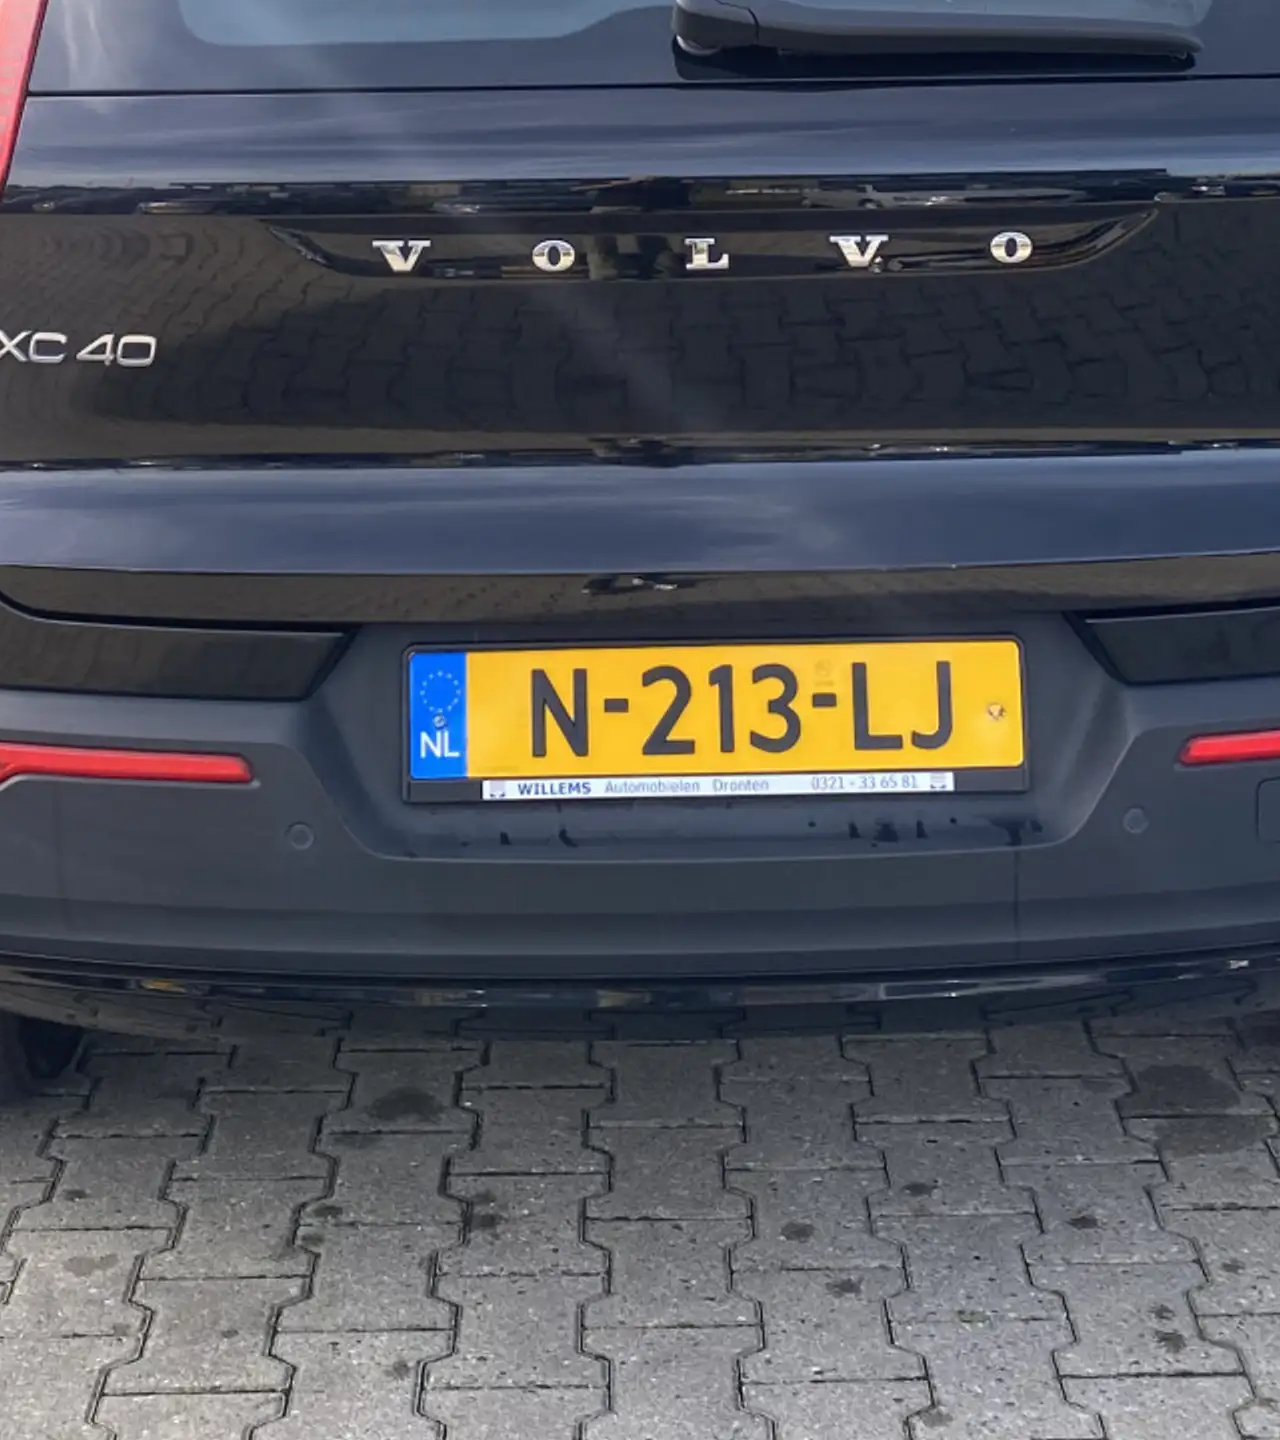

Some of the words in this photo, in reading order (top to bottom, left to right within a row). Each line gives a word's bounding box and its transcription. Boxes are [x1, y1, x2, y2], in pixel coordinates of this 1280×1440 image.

[372, 231, 1033, 272] VOLVO
[531, 661, 954, 758] N-213-LJ
[420, 731, 461, 758] NL
[518, 781, 592, 795] WILLEMS
[604, 780, 700, 794] Automobielen
[712, 778, 769, 792] Dronten
[811, 777, 844, 790] 0321
[861, 776, 876, 789] 33
[901, 775, 918, 788] 81
